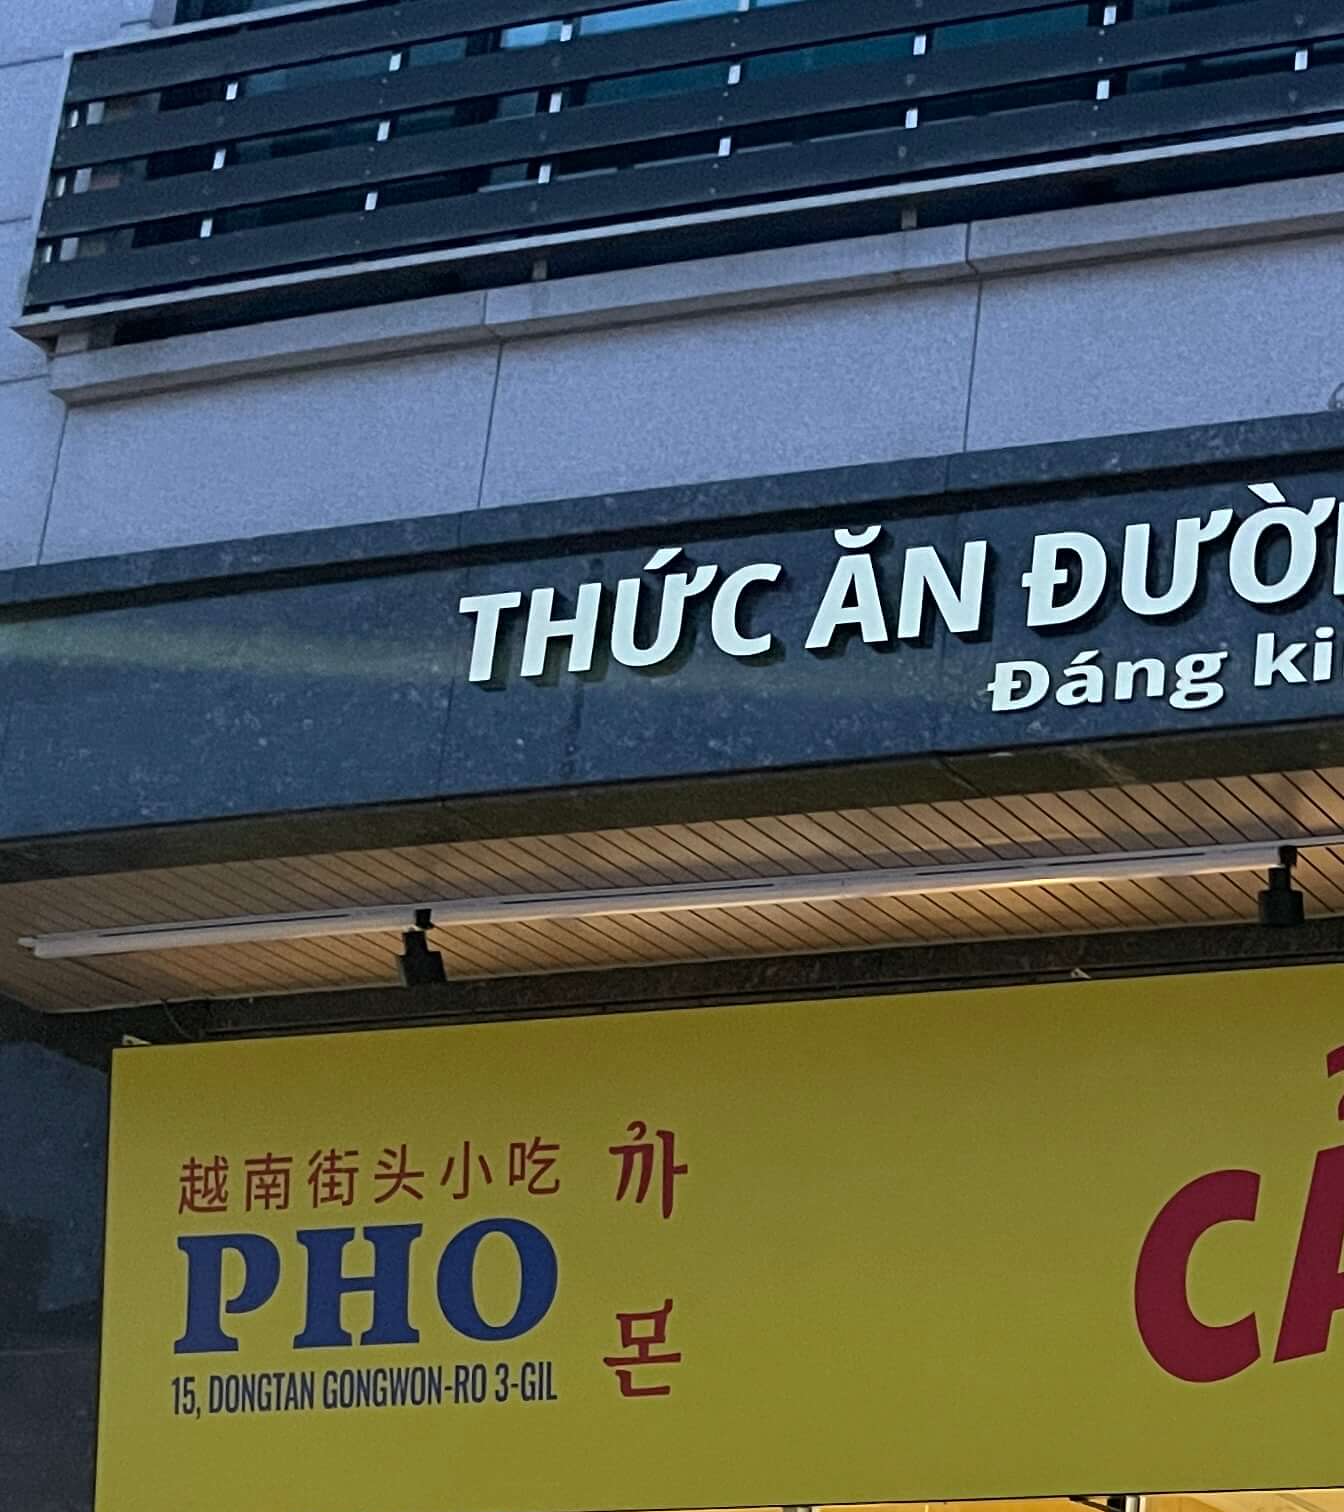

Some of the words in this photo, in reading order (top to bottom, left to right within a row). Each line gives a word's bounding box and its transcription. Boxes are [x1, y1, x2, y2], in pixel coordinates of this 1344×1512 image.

[459, 547, 781, 682] THỨC
[805, 525, 988, 649] ĂN
[986, 650, 1228, 712] Đáng
[178, 1135, 562, 1215] 越南街头小吃
[174, 1217, 558, 1353] PHO
[171, 1375, 202, 1419] 15,
[208, 1370, 315, 1414] DONGTAN
[322, 1364, 487, 1409] GONGWON-RO
[494, 1360, 557, 1402] 3-GIL
